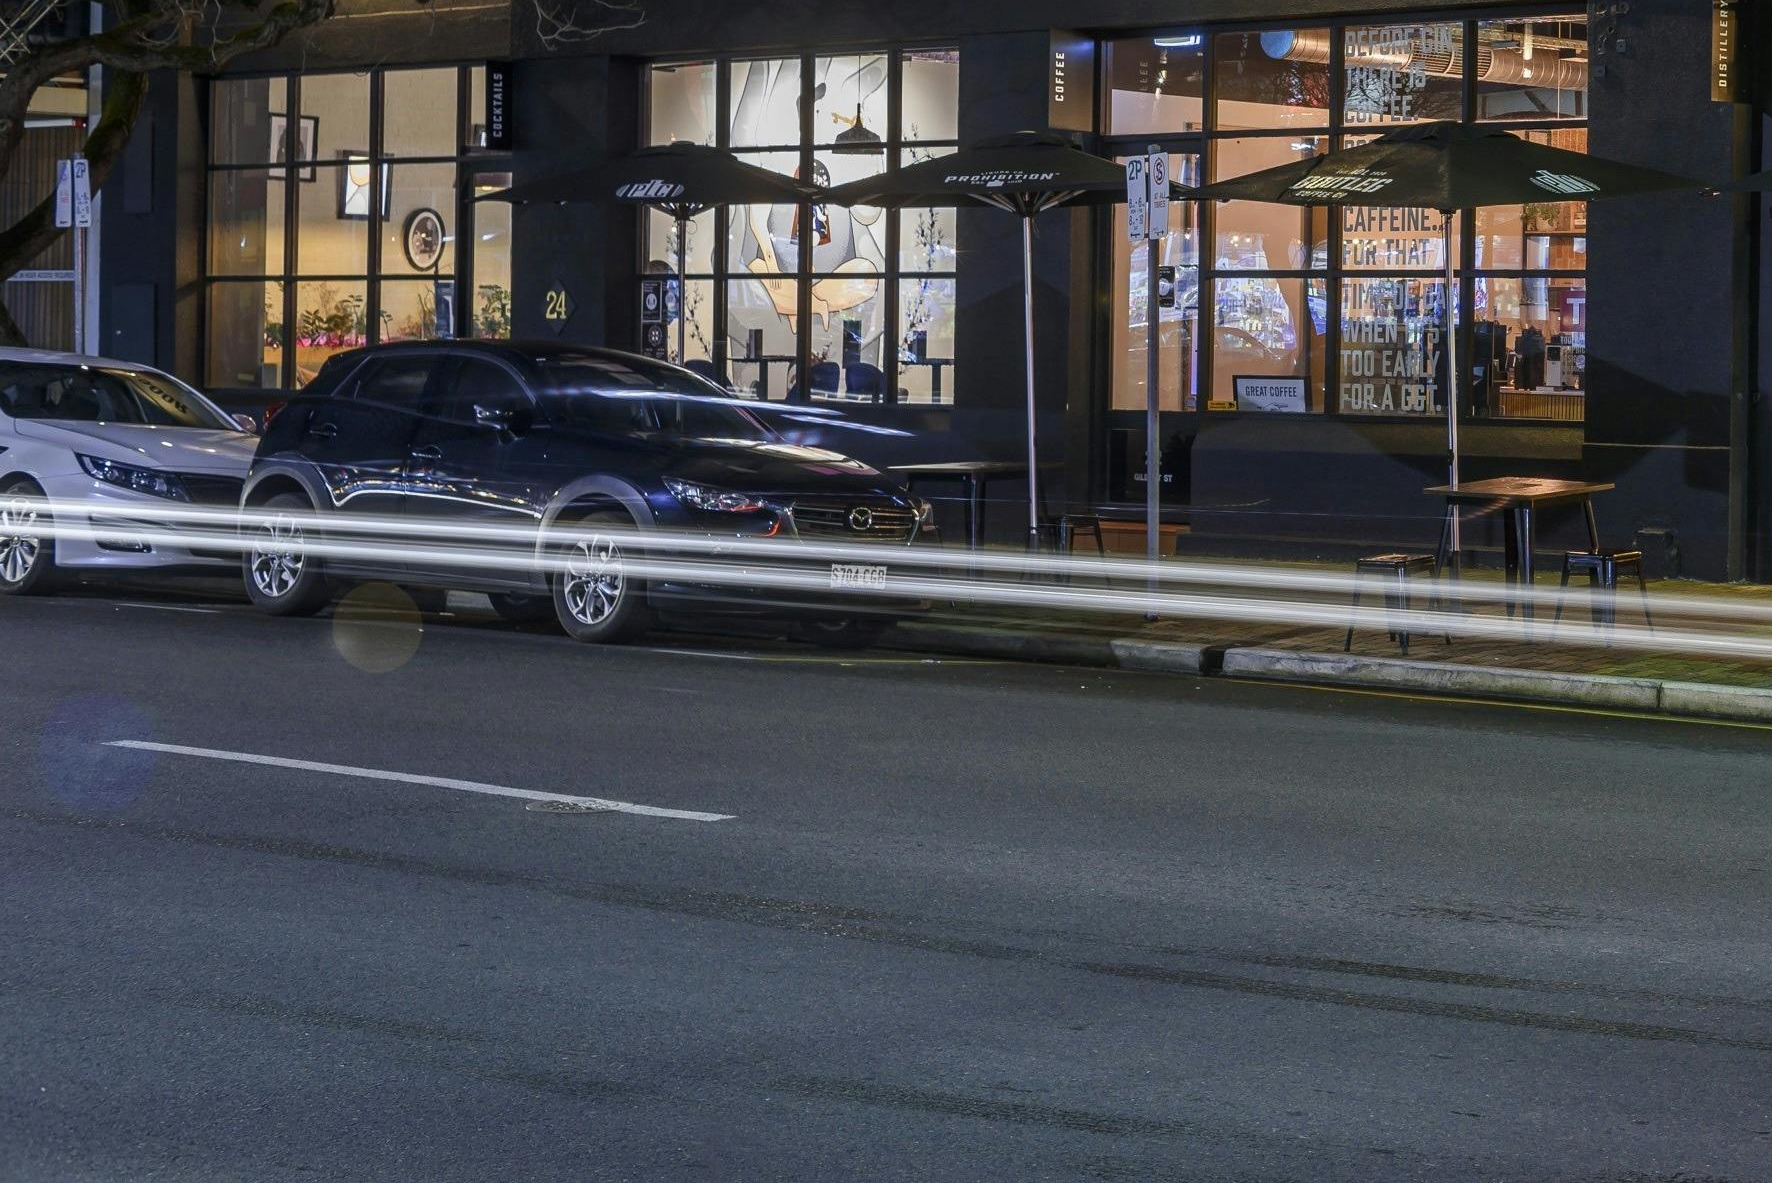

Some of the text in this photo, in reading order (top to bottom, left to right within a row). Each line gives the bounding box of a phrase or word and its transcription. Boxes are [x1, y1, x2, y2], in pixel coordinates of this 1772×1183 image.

[1344, 27, 1414, 58] BEFORE
[1719, 0, 1729, 88] DISTILLERY
[1055, 52, 1065, 102] COFFEE
[1345, 61, 1427, 90] THERE IS
[493, 73, 503, 138] COCKTAILS
[944, 172, 1055, 183] PROHIBITION
[1128, 160, 1142, 181] 2P
[1290, 175, 1393, 193] BOOTLEG
[1342, 238, 1430, 266] FOR THAT
[546, 290, 567, 319] 24
[1424, 283, 1449, 310] DA
[1342, 318, 1398, 344] WHEN
[1340, 350, 1440, 378] TOO EARLY
[1245, 385, 1297, 398] GREAT COFFEE
[1340, 384, 1374, 410] FOR
[1381, 384, 1394, 411] A
[1164, 474, 1173, 482] ST
